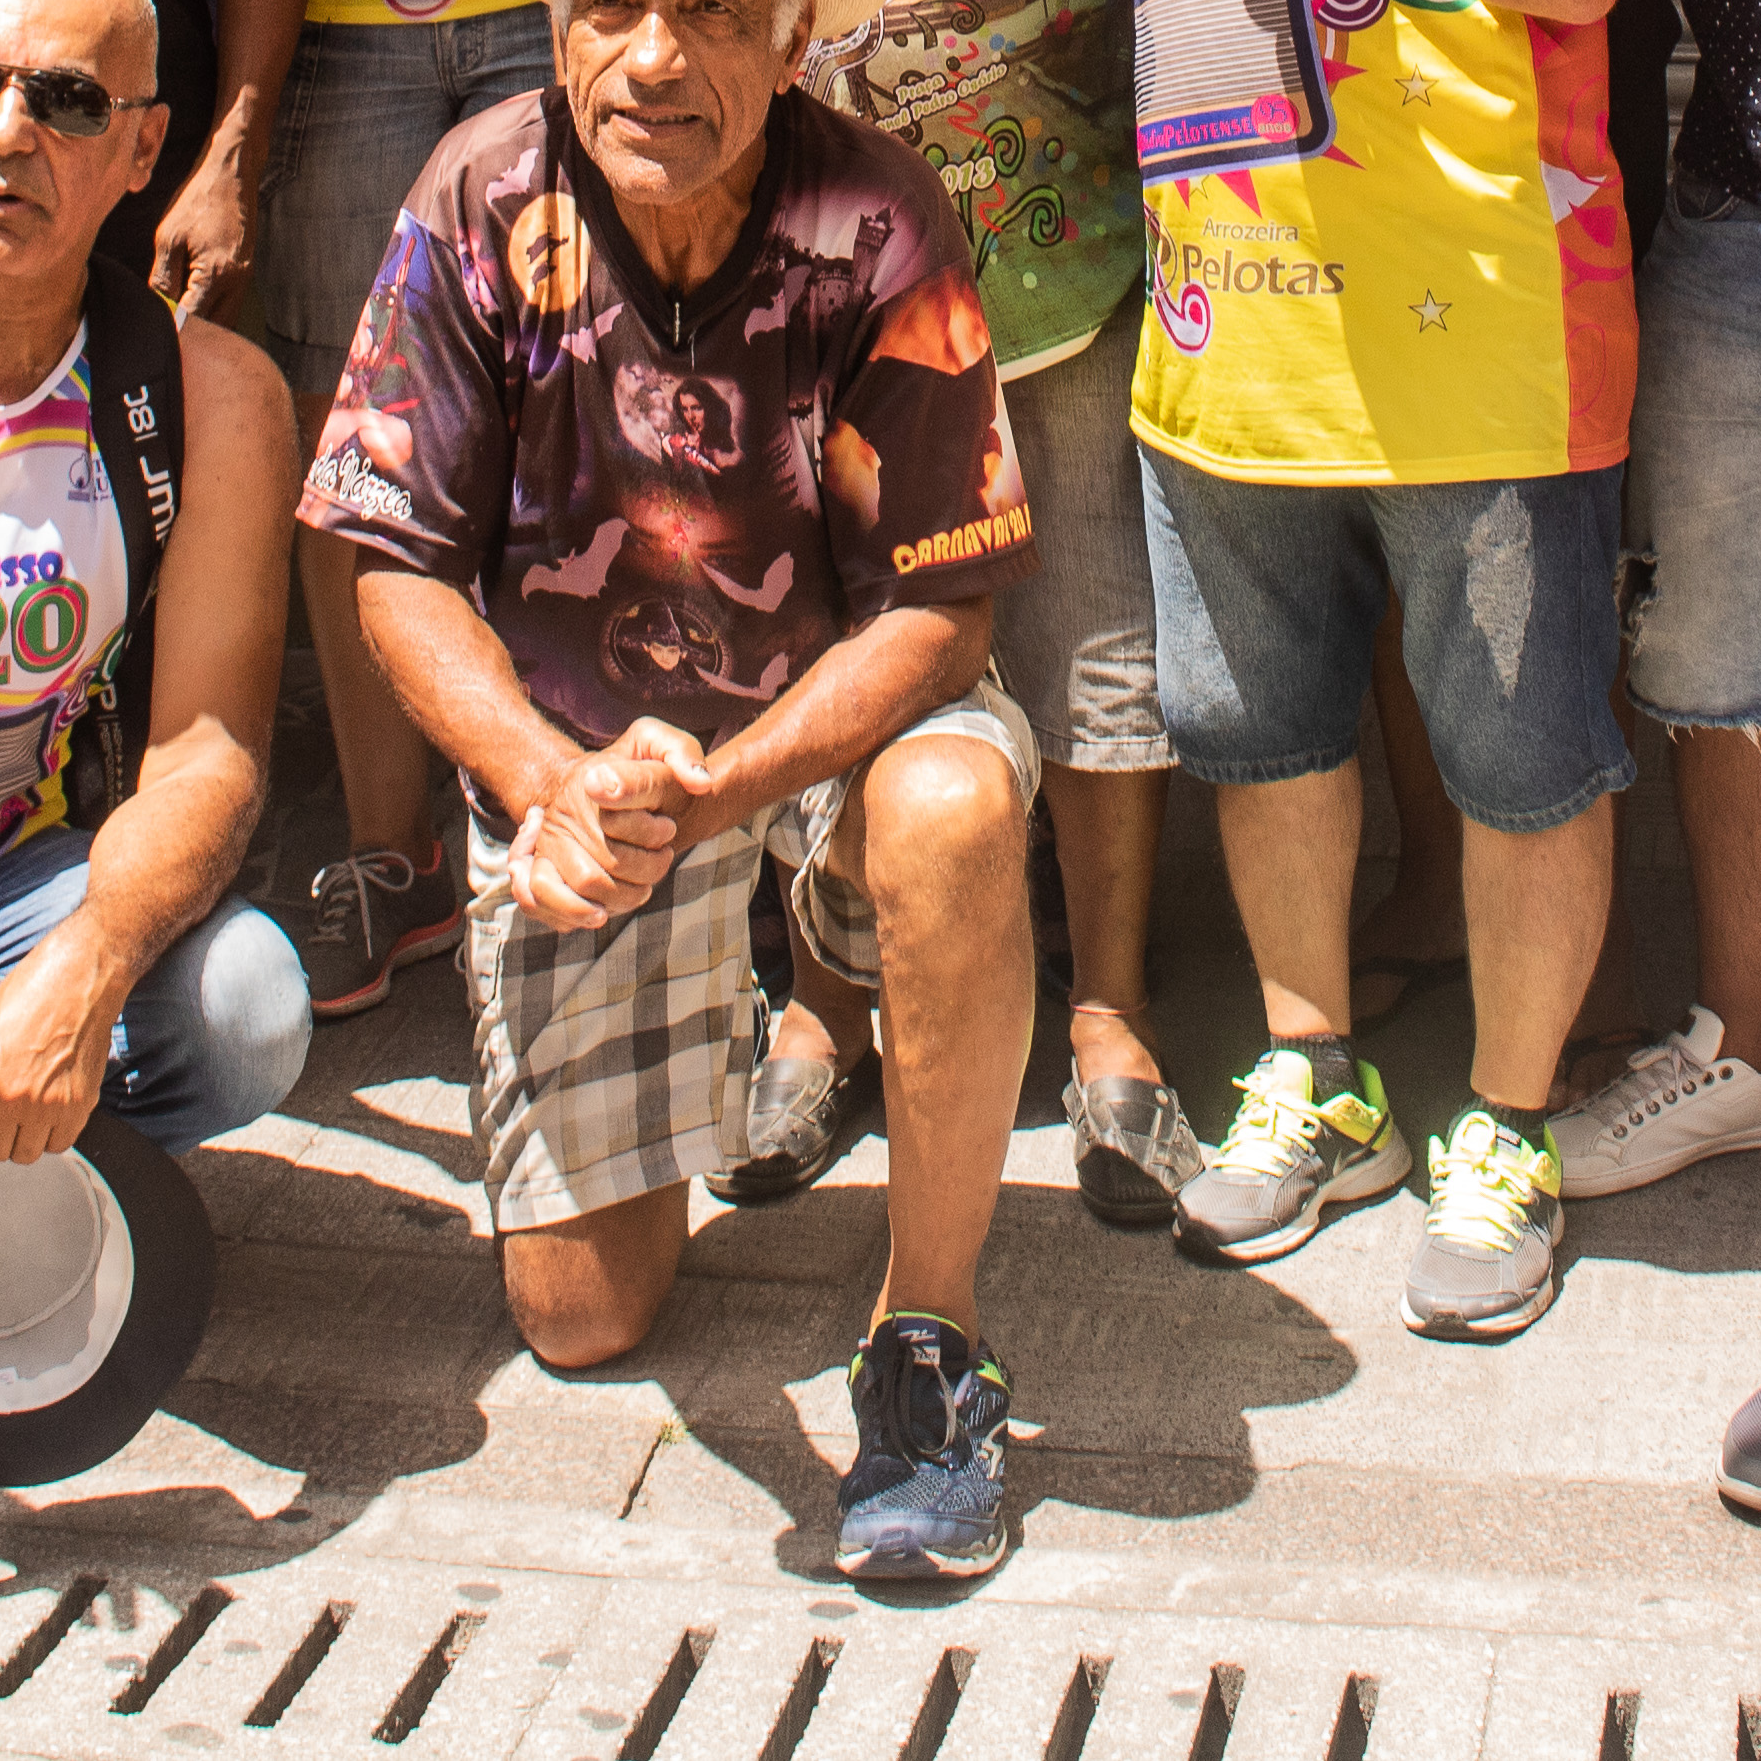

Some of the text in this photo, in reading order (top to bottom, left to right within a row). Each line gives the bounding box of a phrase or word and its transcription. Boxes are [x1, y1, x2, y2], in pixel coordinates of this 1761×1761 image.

[1259, 99, 1288, 124] 95
[941, 155, 997, 196] 013
[1201, 217, 1299, 242] Arrozeira
[1182, 243, 1346, 296] Pelotas
